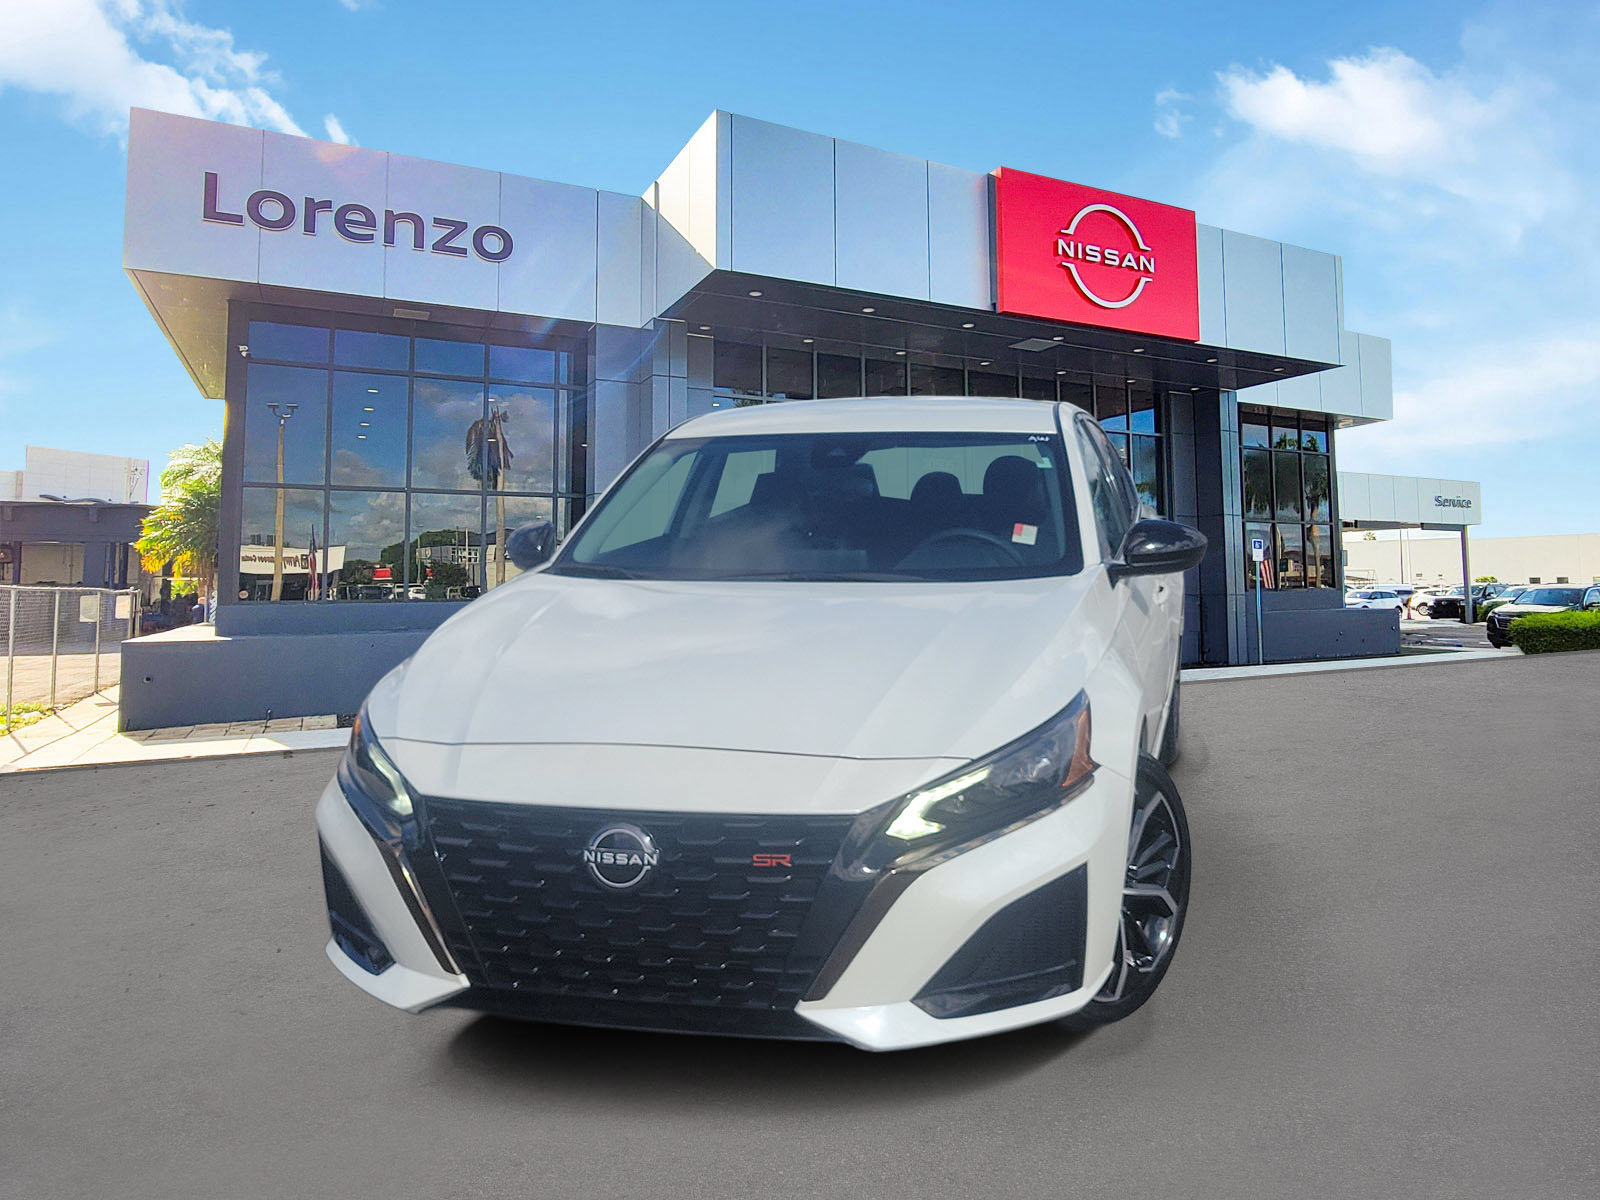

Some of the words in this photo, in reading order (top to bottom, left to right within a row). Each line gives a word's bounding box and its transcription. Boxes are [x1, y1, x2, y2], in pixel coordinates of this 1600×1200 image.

[202, 171, 514, 262] Lorenzo
[1058, 238, 1155, 273] NISSAN
[1434, 495, 1472, 509] Service
[584, 850, 658, 866] NISSAN
[752, 854, 791, 867] SR
